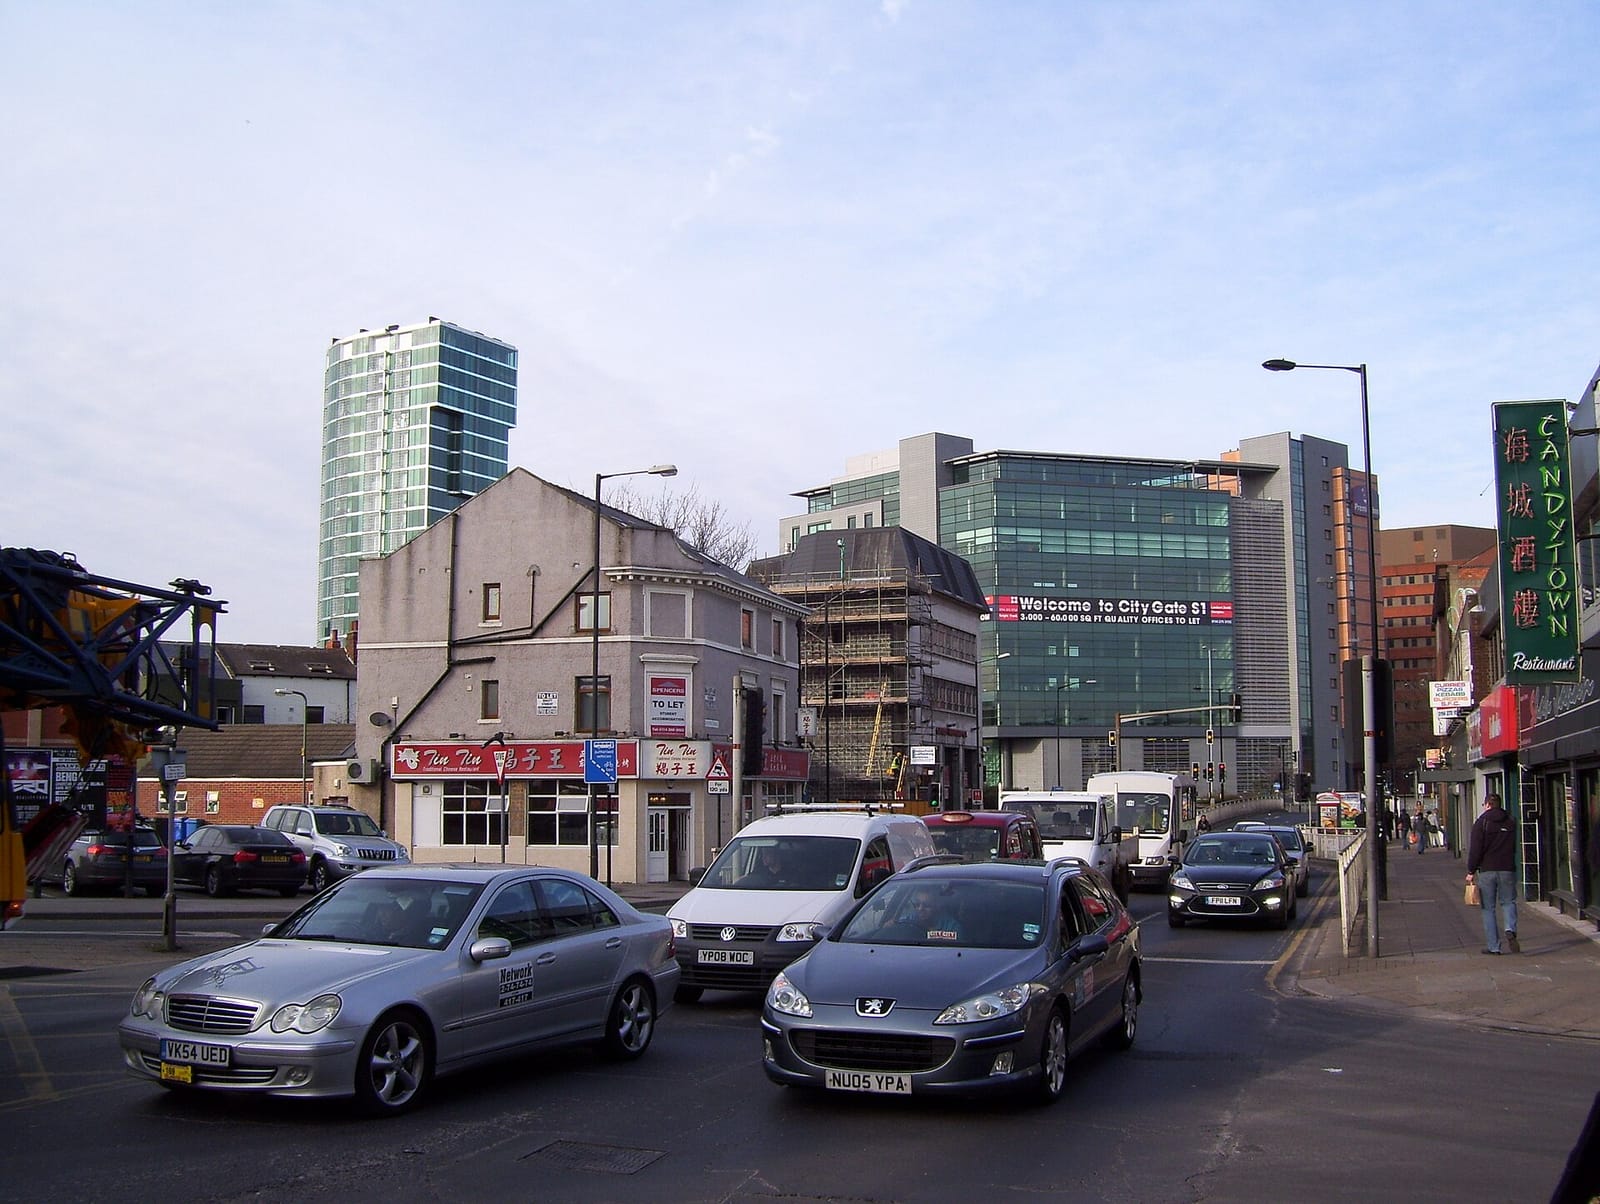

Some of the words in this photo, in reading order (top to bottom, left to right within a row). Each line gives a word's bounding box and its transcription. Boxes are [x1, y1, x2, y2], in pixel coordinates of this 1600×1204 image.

[1503, 427, 1539, 629] 海城酒樓
[1538, 415, 1571, 637] CANDYTOWN
[1020, 597, 1091, 612] Welcome
[1099, 599, 1114, 612] to
[1191, 602, 1206, 615] S1
[1020, 613, 1043, 621] 3,000
[1050, 614, 1078, 622] 60,000
[1080, 614, 1092, 622] SQ
[1094, 615, 1102, 623] FT
[1105, 615, 1139, 623] QUALITY
[1141, 616, 1173, 624] OFFICES
[1188, 617, 1200, 625] LET
[1513, 651, 1576, 671] Restaurant
[652, 700, 665, 708] TO
[423, 749, 450, 766] Tin
[455, 749, 482, 766] Tin
[656, 744, 674, 756] Tin
[679, 744, 697, 756] Tin
[702, 951, 727, 962] YP08
[501, 963, 532, 983] Network
[167, 1041, 197, 1060] VK54
[201, 1046, 227, 1063] UED
[832, 1073, 871, 1089] NU05
[876, 1075, 905, 1091] YPA
